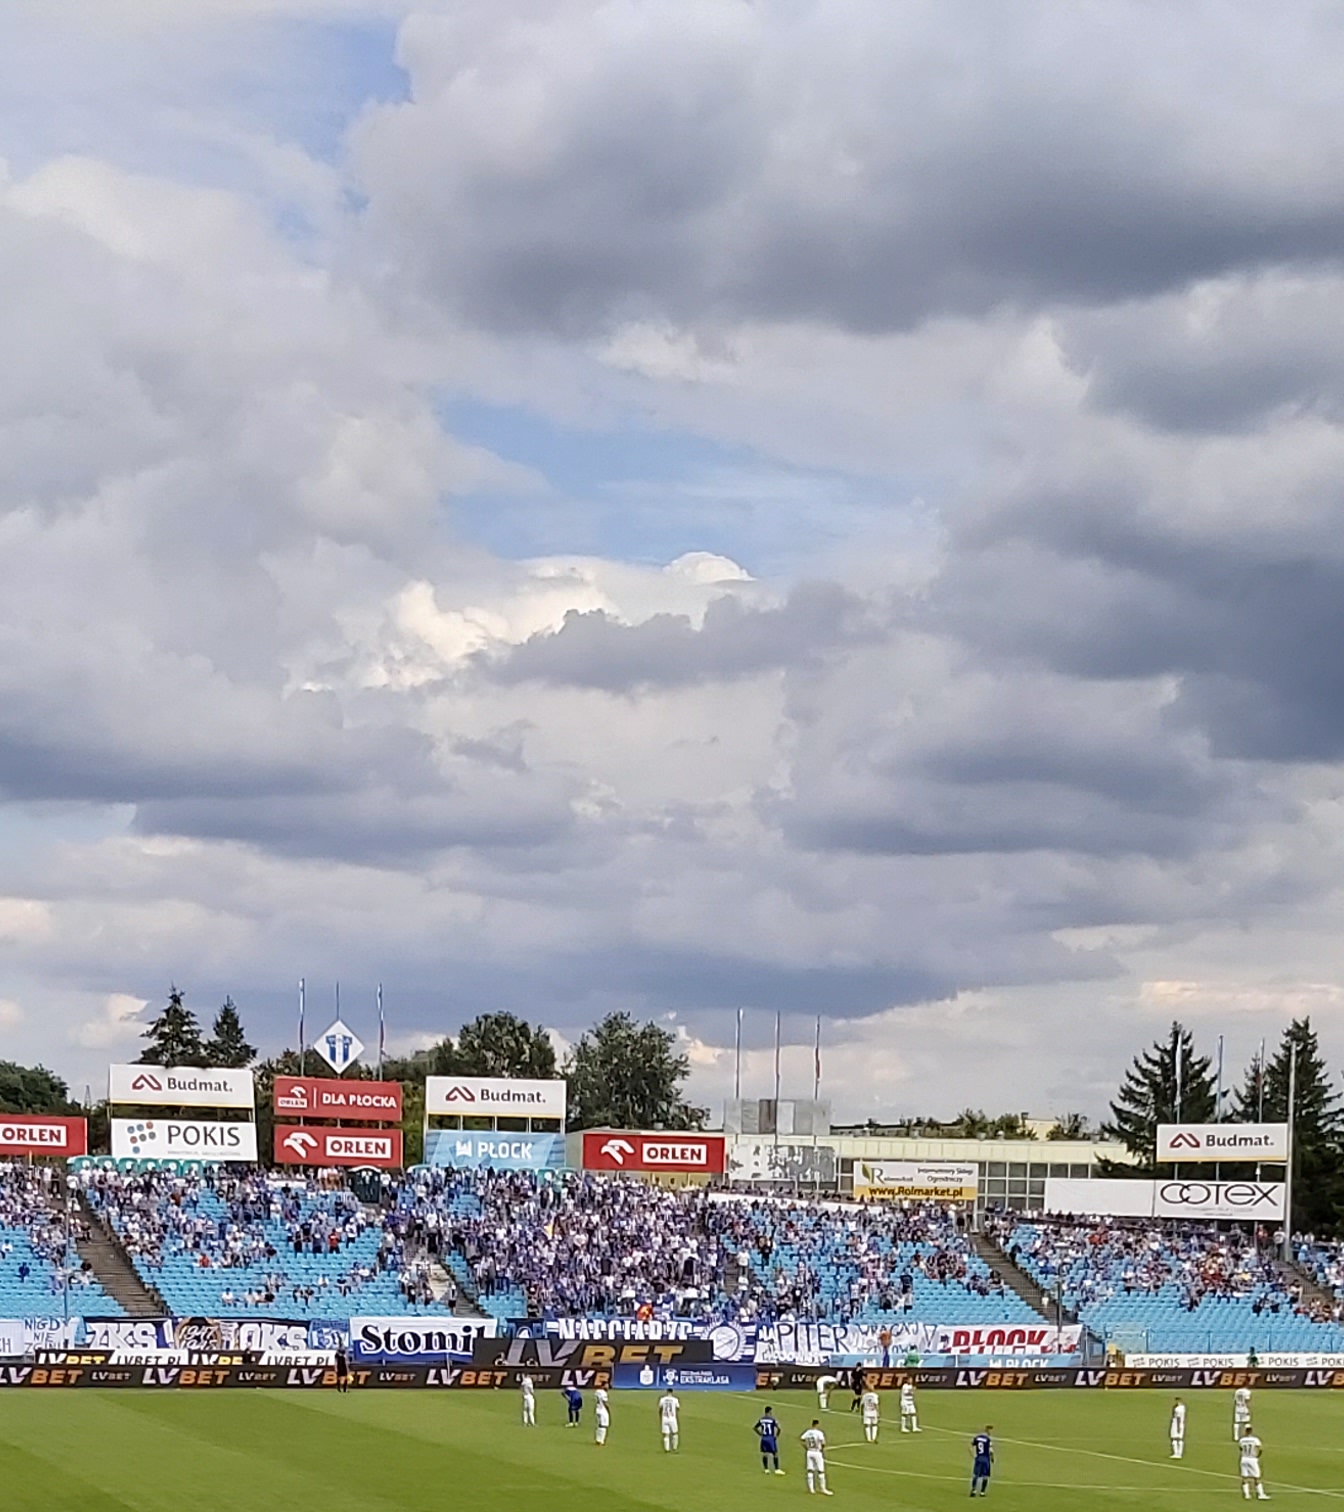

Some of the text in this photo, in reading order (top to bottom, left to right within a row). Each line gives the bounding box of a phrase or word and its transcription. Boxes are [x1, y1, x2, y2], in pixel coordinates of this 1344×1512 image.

[167, 1077, 233, 1092] Budmat.
[322, 1093, 346, 1105] DLA
[349, 1094, 397, 1108] PŁOCKA
[480, 1088, 546, 1104] Budmat.
[2, 1127, 62, 1143] ORLEN
[167, 1125, 240, 1146] POKIS
[1206, 1134, 1274, 1147] Budmat.
[330, 1140, 386, 1155] ORLEN
[478, 1141, 532, 1159] PŁOCK
[647, 1147, 702, 1161] ORLEN
[1149, 1357, 1180, 1367] POKIS
[1203, 1357, 1235, 1367] POKIS
[1268, 1356, 1299, 1366] POKIS
[142, 1368, 230, 1385] LVBET
[287, 1369, 371, 1385] LVBT
[426, 1370, 508, 1385] LVBET
[957, 1371, 1028, 1386] LVBET
[1075, 1371, 1146, 1386] LVBET
[1191, 1371, 1259, 1386] LVBET
